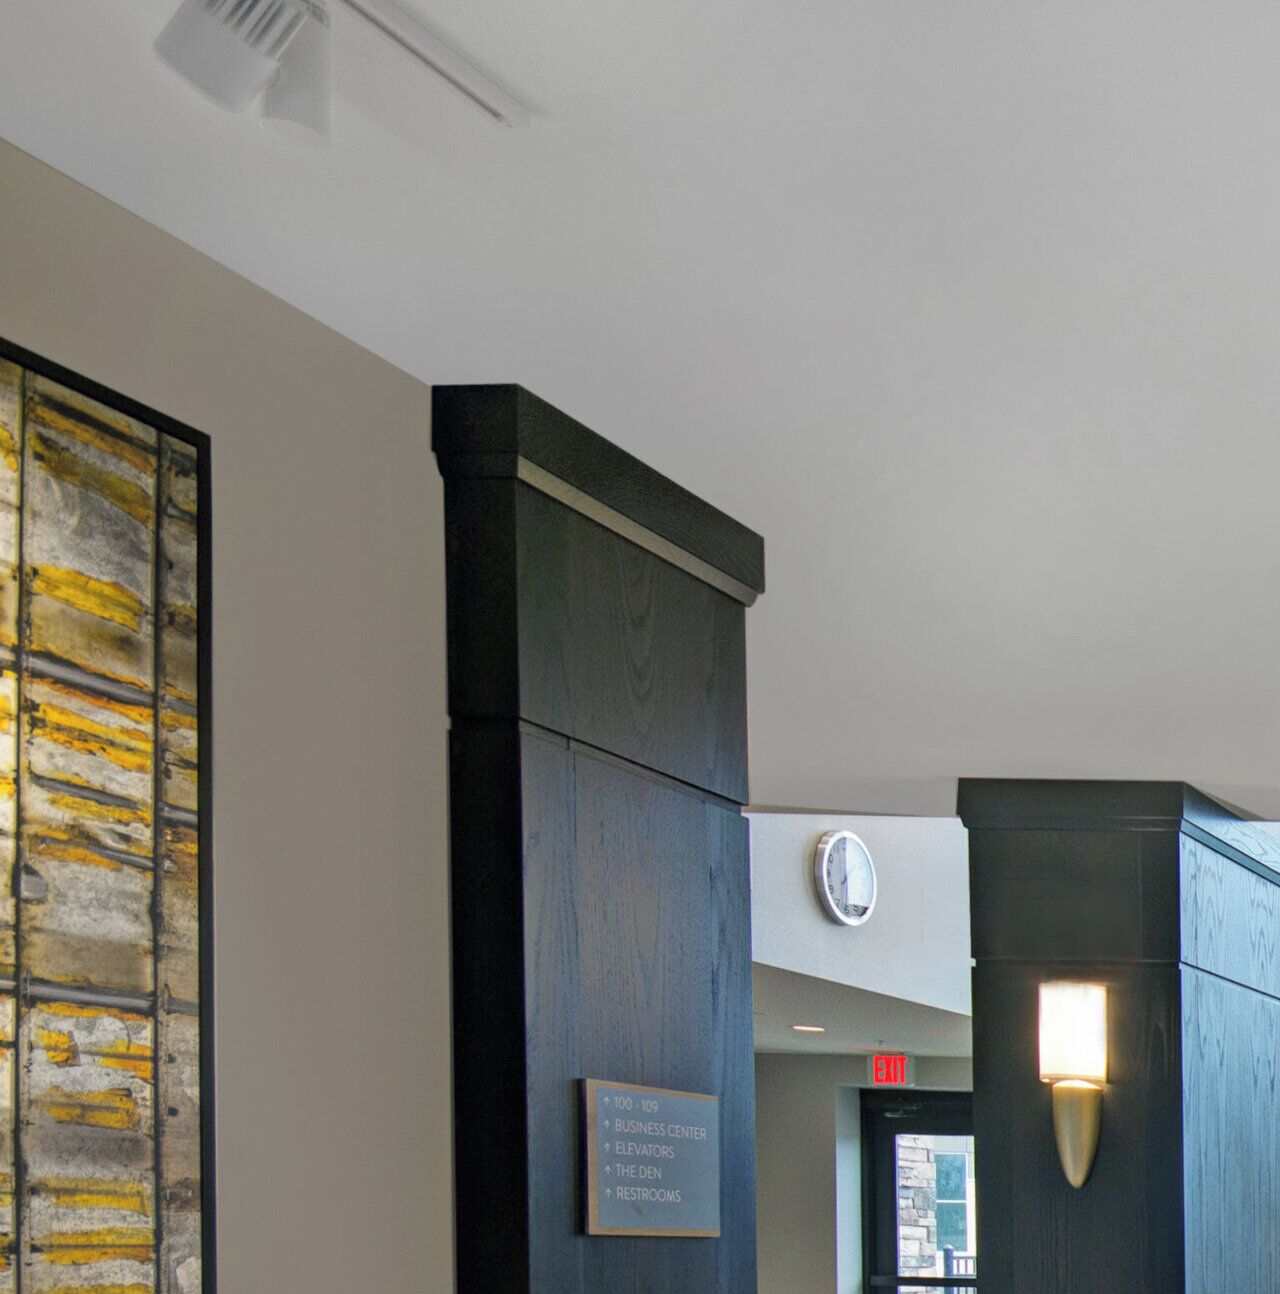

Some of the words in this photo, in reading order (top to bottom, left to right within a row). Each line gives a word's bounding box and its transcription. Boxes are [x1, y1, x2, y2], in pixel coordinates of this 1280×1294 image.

[874, 1055, 907, 1084] EXIT
[614, 1096, 633, 1110] 100
[641, 1100, 659, 1113] 109
[615, 1118, 666, 1136] BUSINESS
[667, 1124, 707, 1140] CENTER
[615, 1141, 675, 1158] ELEVATORS
[615, 1164, 637, 1178] THE
[639, 1165, 662, 1179] DEN
[616, 1186, 682, 1203] RESTROOMS
